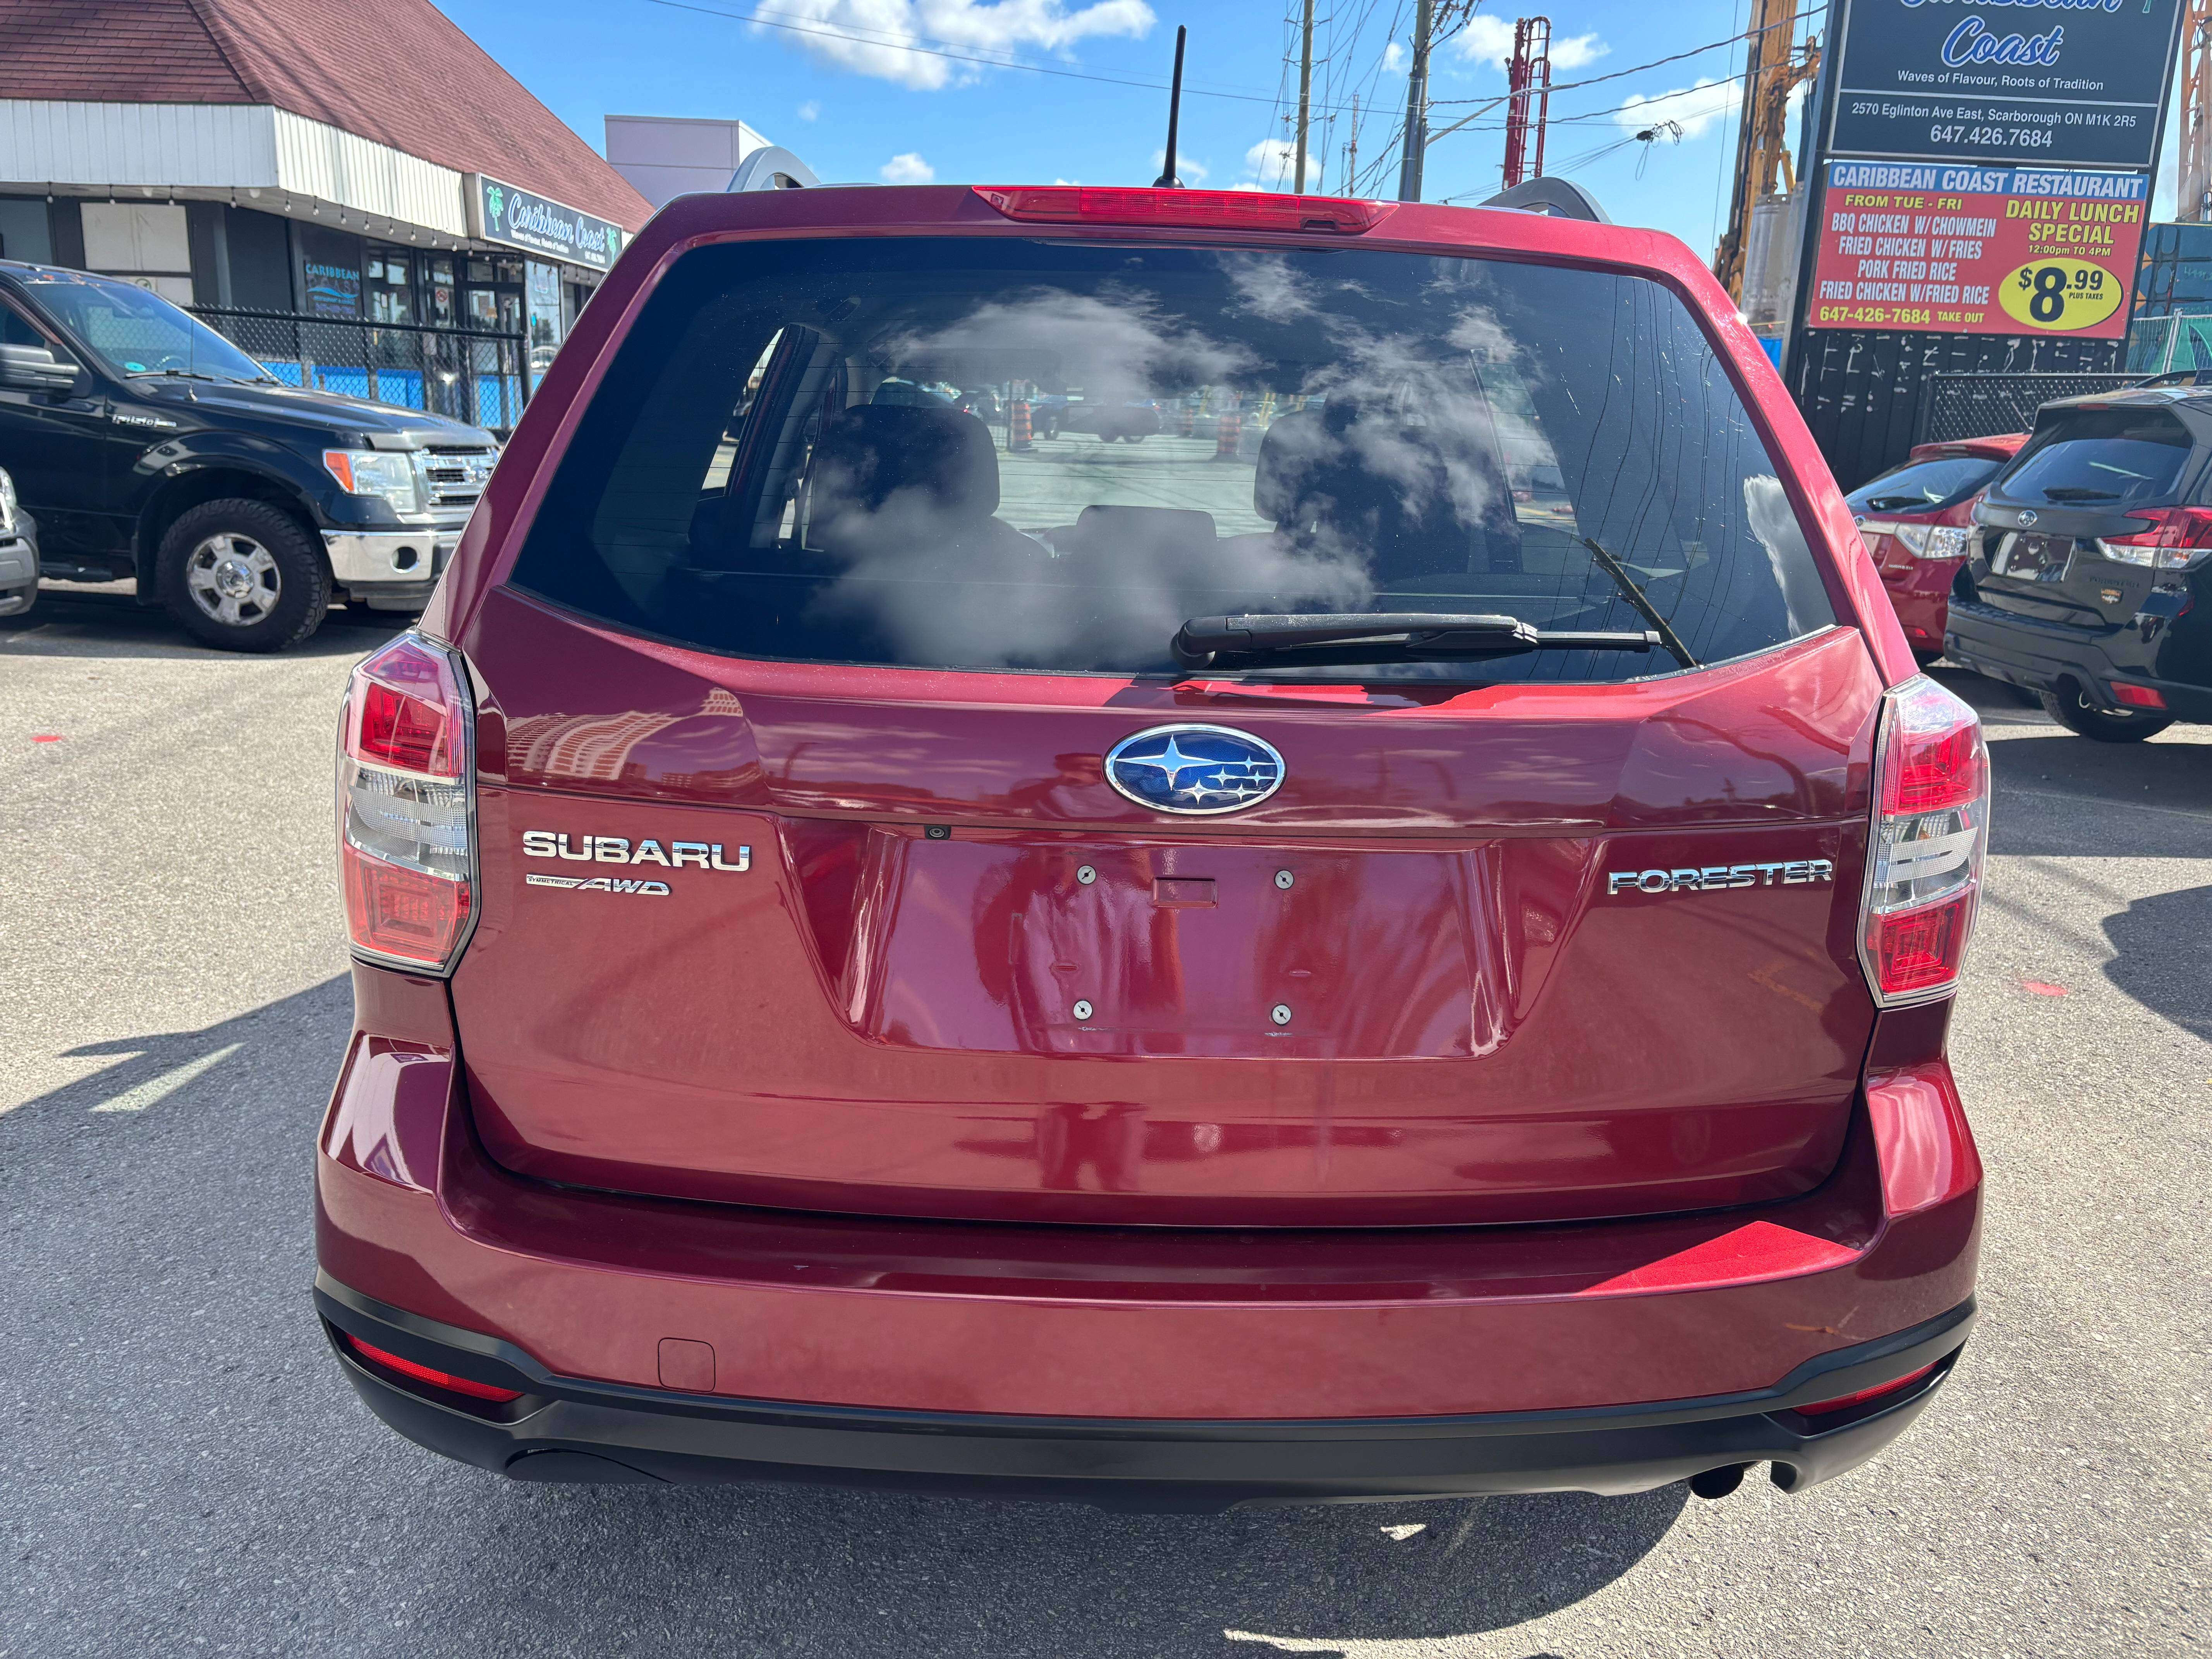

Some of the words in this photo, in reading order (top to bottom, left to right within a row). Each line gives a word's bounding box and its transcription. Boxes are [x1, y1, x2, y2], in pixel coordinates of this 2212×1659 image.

[1941, 15, 2064, 67] Coast
[1898, 70, 1934, 82] Waves
[1937, 72, 1950, 82] of
[1953, 73, 1997, 87] Flavour,
[2001, 75, 2035, 88] Roots
[2039, 77, 2051, 88] of
[2053, 78, 2104, 90] Tradition
[1852, 102, 1879, 115] 2570
[1882, 103, 1929, 118] Eglinton
[1931, 106, 1953, 118] Ave
[1956, 107, 1984, 122] East,
[1988, 108, 2061, 126] Scarborough
[2065, 112, 2083, 125] ON
[2086, 114, 2112, 126] M1K
[2114, 115, 2136, 127] 2R5
[1930, 124, 2052, 148] 647.426.7684
[1834, 166, 1936, 189] CARIBBEAN
[1942, 170, 2008, 192] COAST
[2012, 173, 2143, 198] RESTAURANT
[1845, 195, 1888, 207] FROM
[1894, 196, 1924, 209] TUE
[1937, 198, 1962, 210] FRI
[2005, 199, 2064, 220] DAILY
[2069, 203, 2139, 223] LUNCH
[508, 193, 574, 244] Caribbean
[1831, 213, 1855, 234] BBQ
[1858, 213, 1910, 234] CHICKEN
[2028, 222, 2114, 244] SPECIAL
[1838, 236, 1872, 256] FRIED
[1875, 237, 1926, 257] CHICKEN
[2029, 244, 2069, 256] 12:00pm
[2073, 246, 2086, 256] TO
[2089, 247, 2111, 256] 4PM
[306, 264, 359, 280] CARIBBEAN
[1857, 259, 1891, 279] PORK
[1892, 261, 1926, 280] FRIED
[1929, 262, 1957, 281] RICE
[1819, 280, 1853, 300] FRIED
[1856, 282, 1906, 302] CHICKEN
[1962, 285, 1990, 305] RICE
[1820, 306, 1930, 324] 647-426-7684
[1937, 312, 1961, 322] TAKE
[1964, 312, 1984, 323] OUT
[523, 831, 751, 871] SUBARU
[528, 876, 573, 886] SYMMETRICAL
[577, 878, 670, 895] AWD
[1607, 859, 1832, 895] FORESTER
